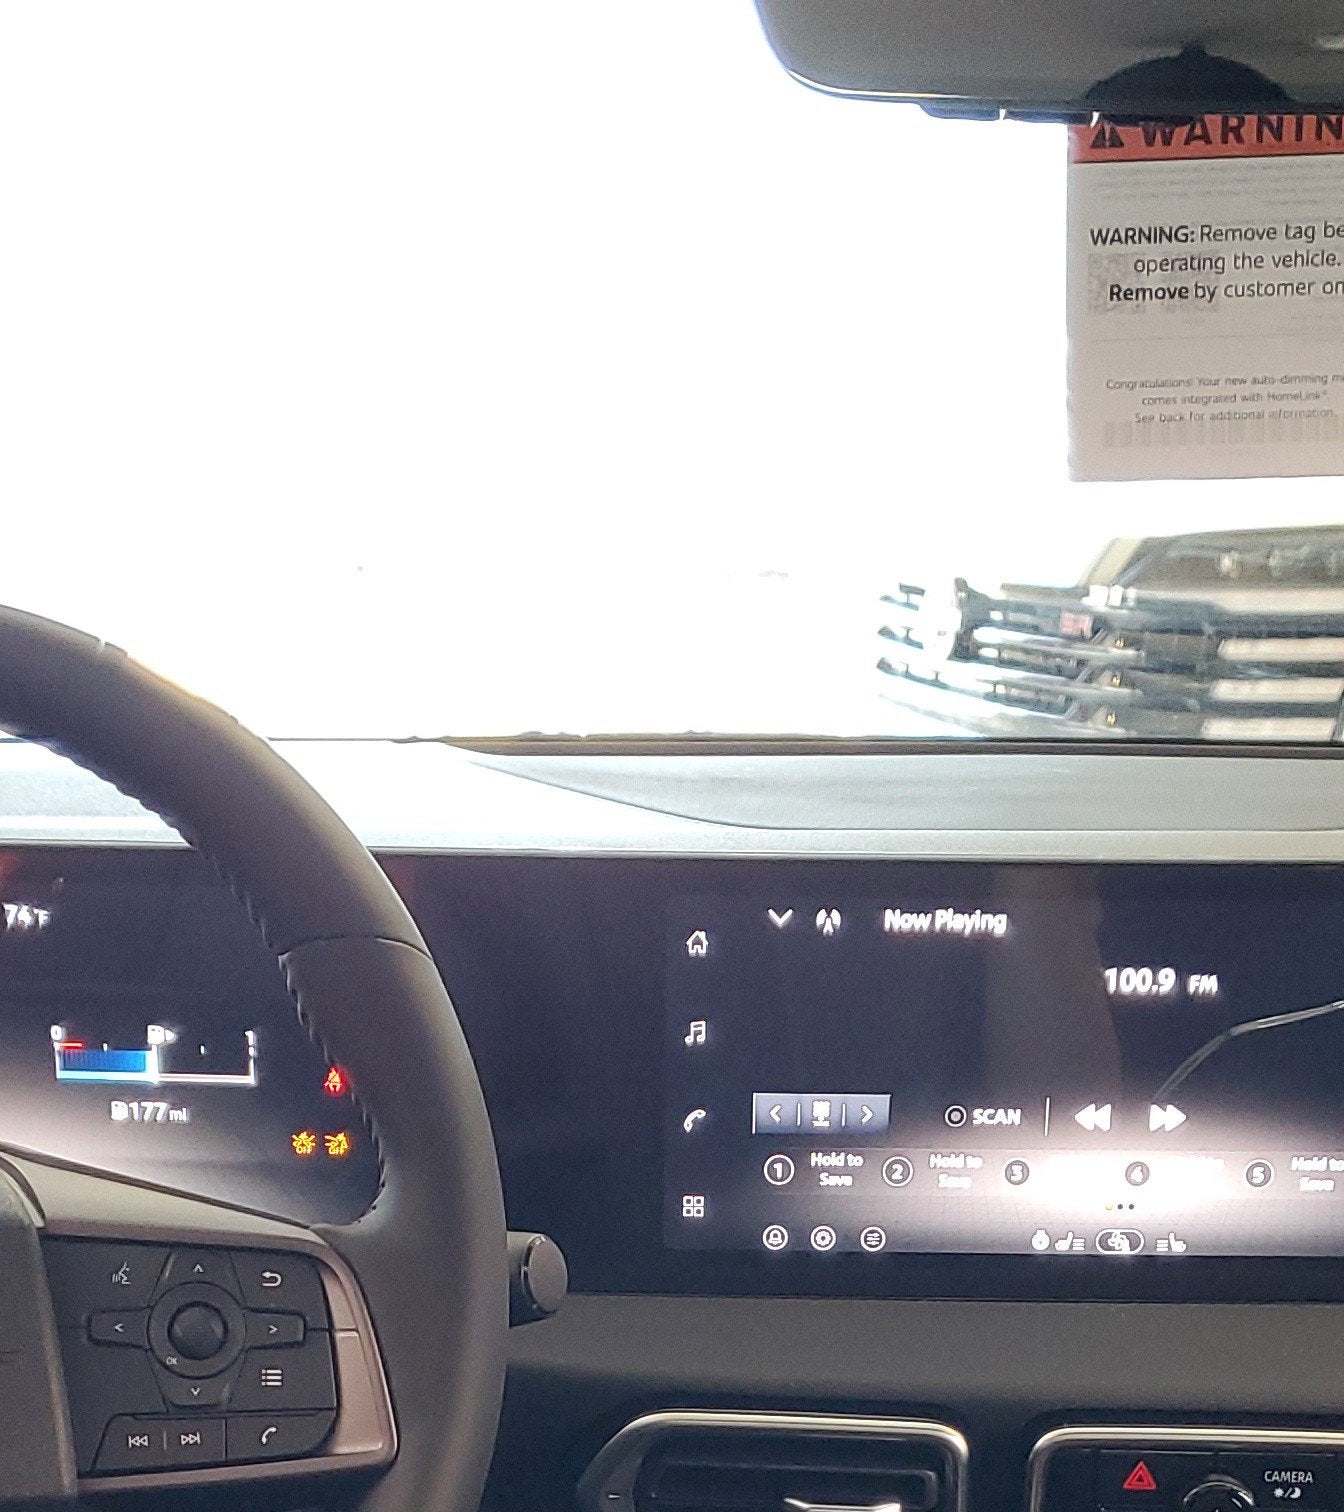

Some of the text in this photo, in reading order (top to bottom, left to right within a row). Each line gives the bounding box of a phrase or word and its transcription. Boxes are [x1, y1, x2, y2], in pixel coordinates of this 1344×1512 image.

[1090, 224, 1195, 246] WARNING:
[1200, 224, 1277, 243] Remove
[1284, 222, 1316, 243] tag
[1133, 250, 1342, 275] operating the vehicle.
[1109, 284, 1189, 302] Remove
[1194, 282, 1217, 303] by
[1224, 280, 1315, 298] customer
[1225, 378, 1248, 387] new
[1240, 392, 1263, 402] with
[1189, 411, 1206, 422] for
[884, 908, 1008, 935] Now Playing
[1104, 968, 1218, 994] 100.9 FM
[129, 1102, 167, 1121] 177
[972, 1108, 1022, 1127] SCAN
[810, 1152, 864, 1167] Hold to
[929, 1153, 983, 1169] Hold to
[1291, 1156, 1327, 1172] Hold
[773, 1162, 783, 1179] 1
[891, 1164, 904, 1180] 2
[1251, 1166, 1265, 1184] 5
[819, 1173, 853, 1187] Save
[1264, 1470, 1313, 1484] CAMERA
